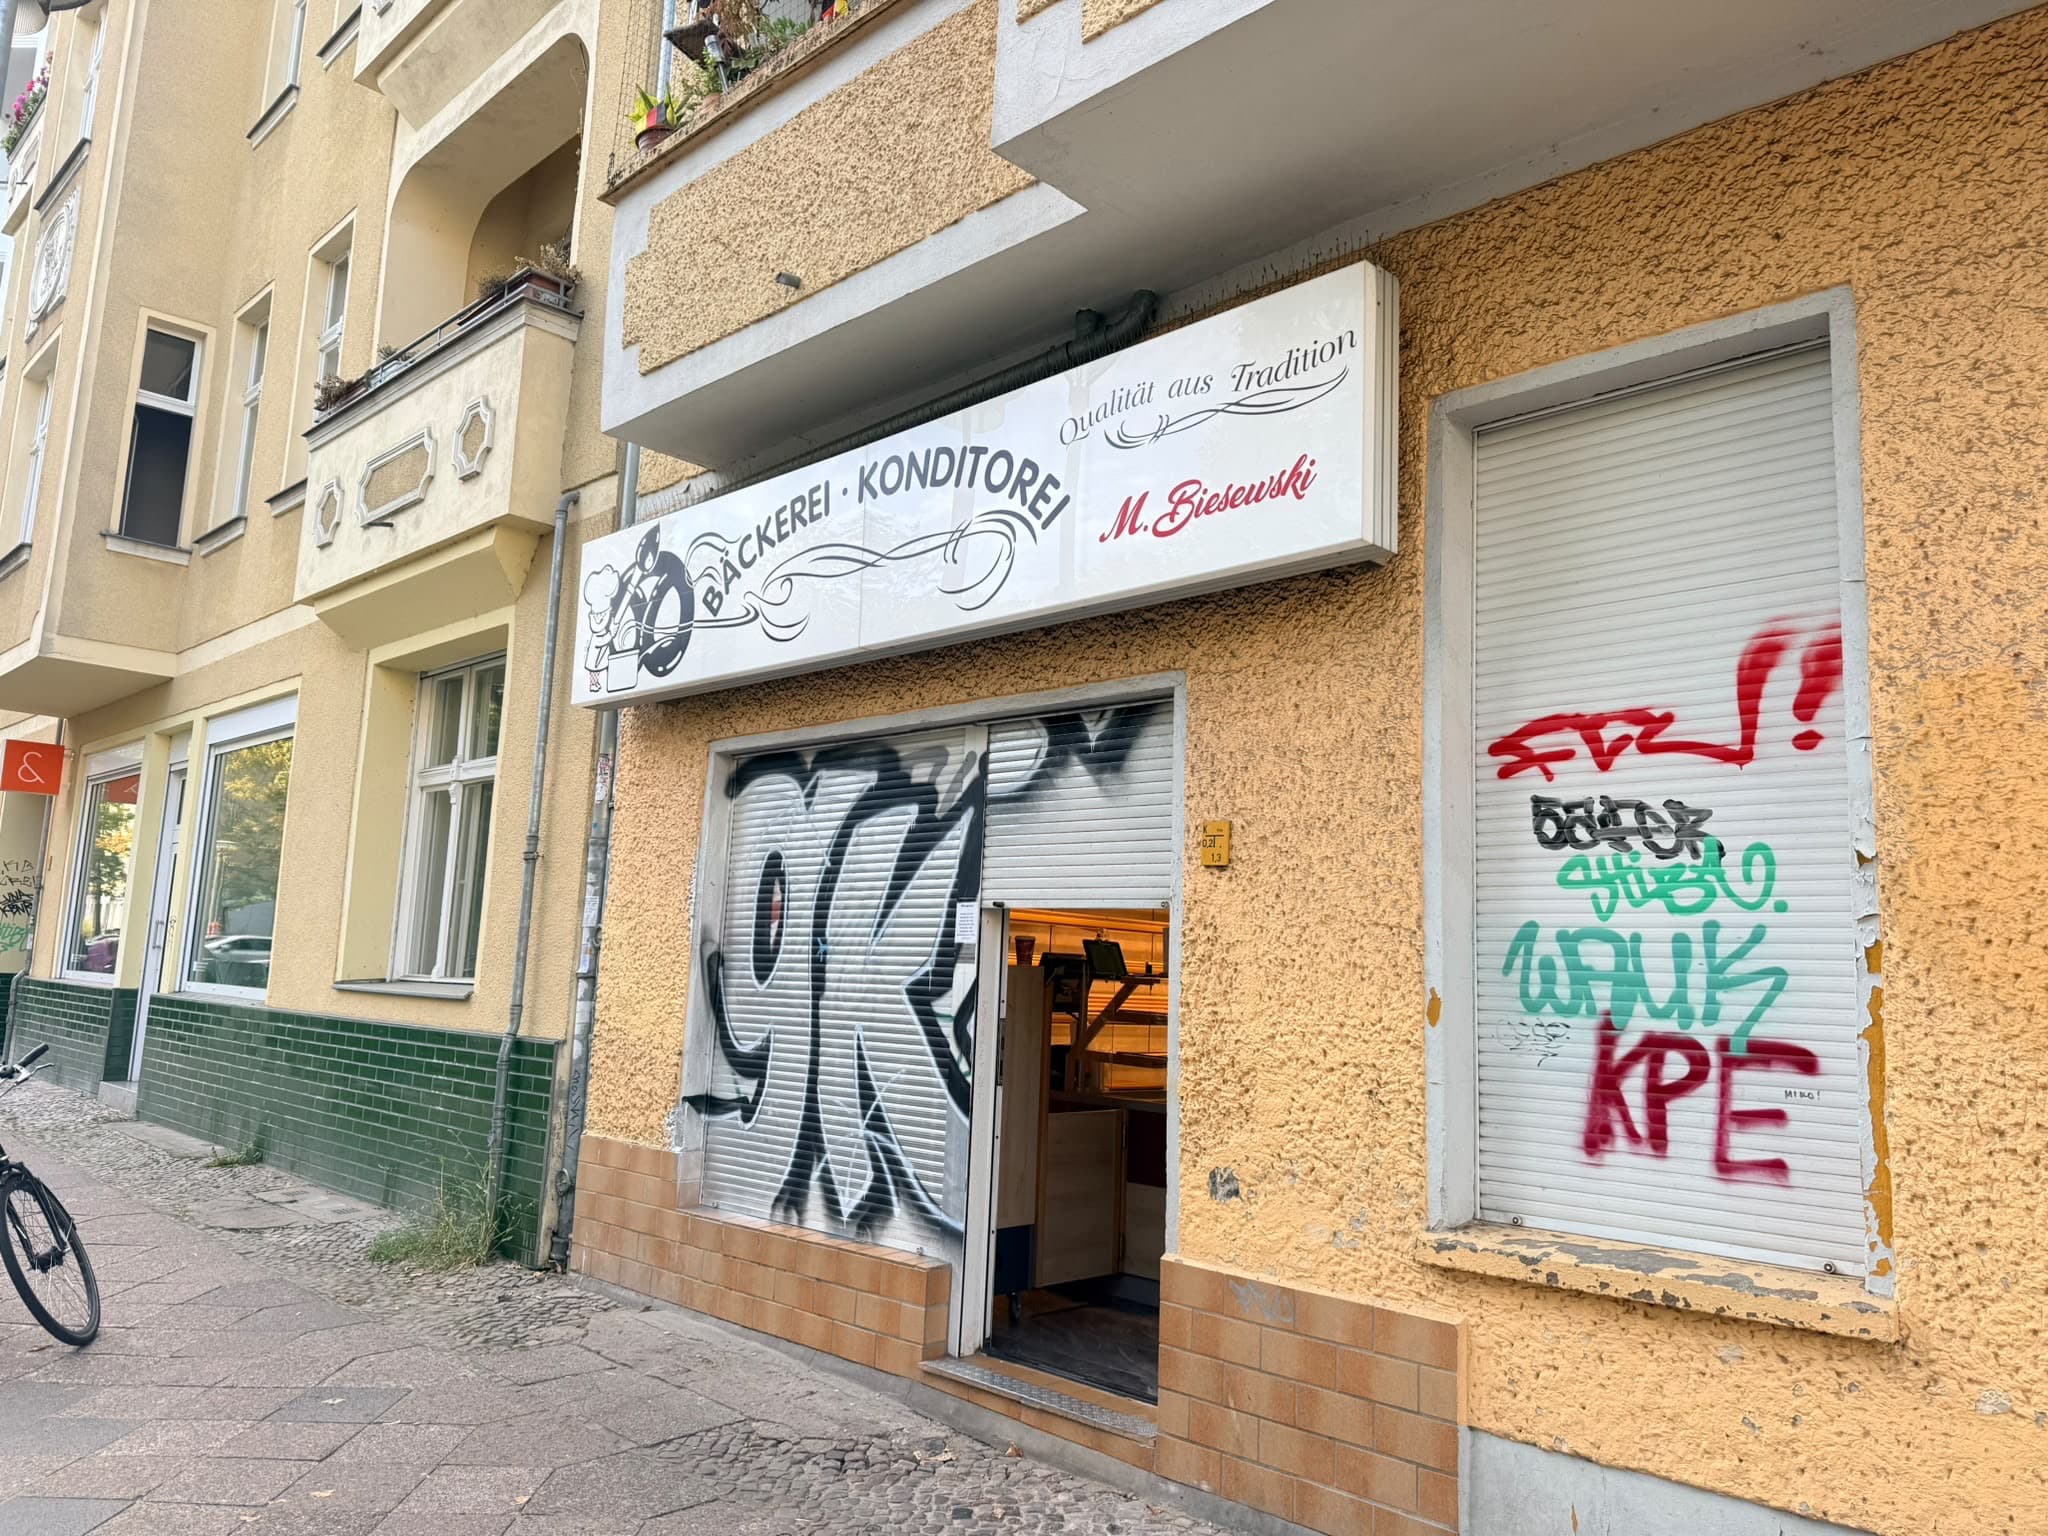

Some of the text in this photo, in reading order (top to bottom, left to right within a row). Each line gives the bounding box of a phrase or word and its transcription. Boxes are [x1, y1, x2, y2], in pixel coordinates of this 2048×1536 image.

[1059, 329, 1358, 449] Qualität aus Tradition
[702, 445, 1071, 617] BÄCKEREI KONDITOREI
